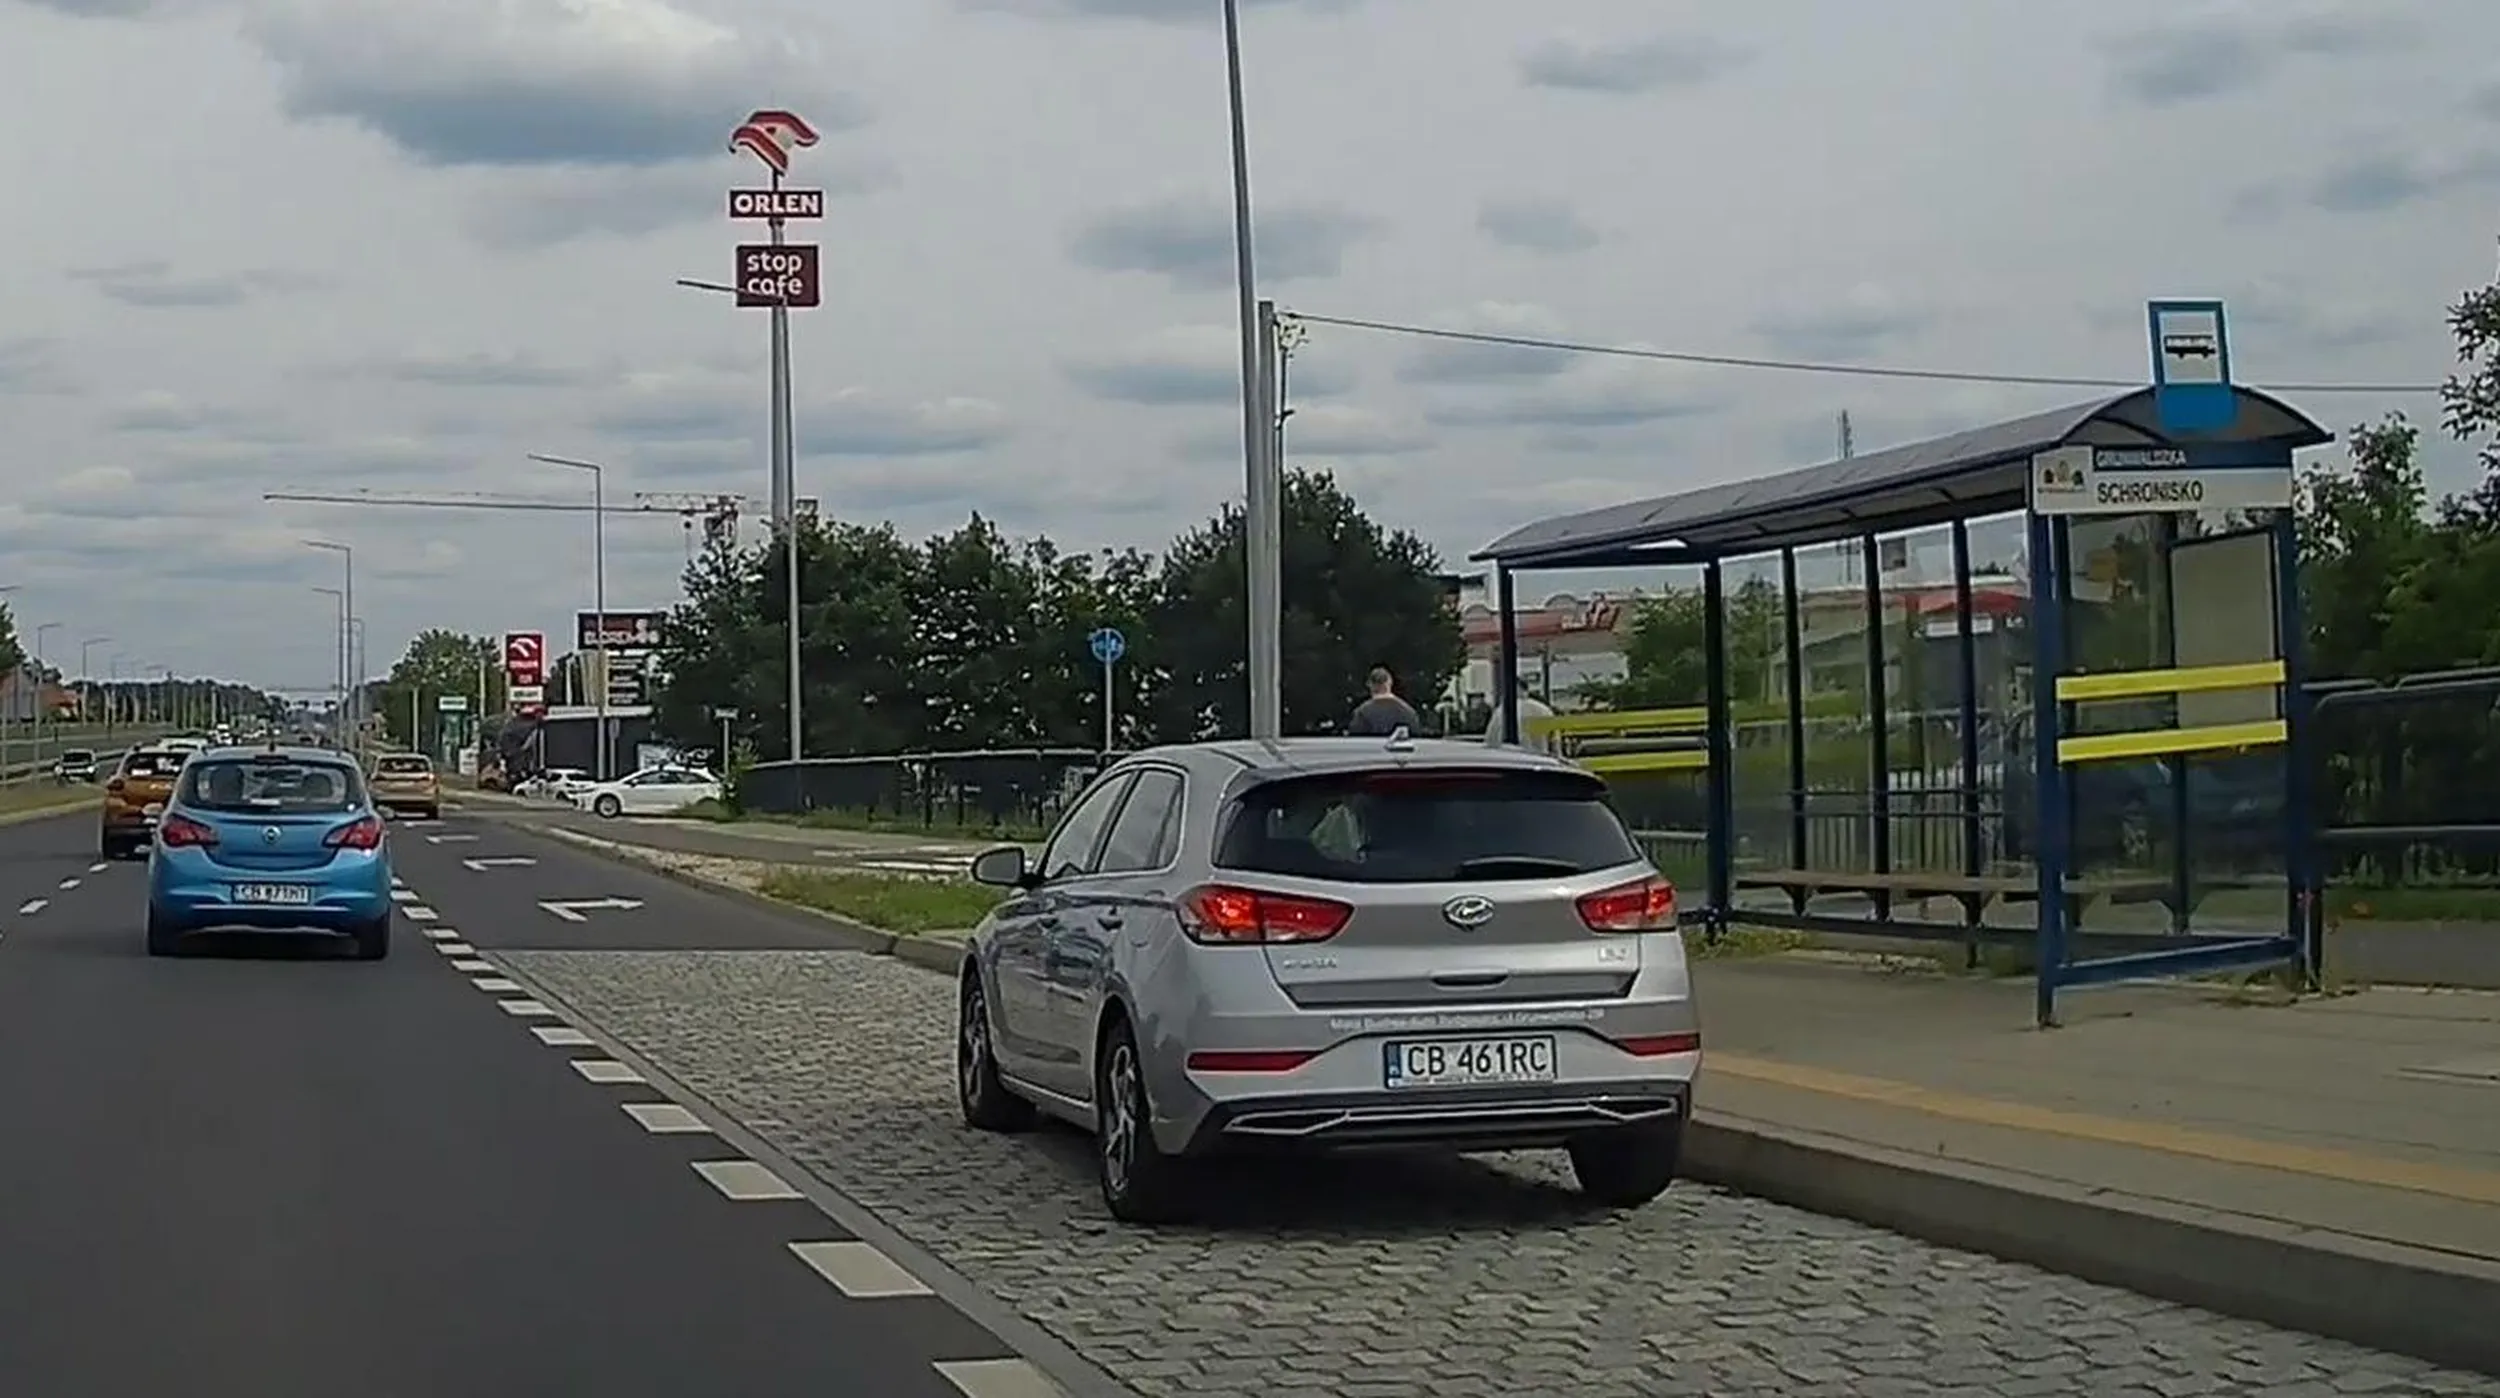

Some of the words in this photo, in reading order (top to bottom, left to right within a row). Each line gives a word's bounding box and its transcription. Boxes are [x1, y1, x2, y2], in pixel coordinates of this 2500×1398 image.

[734, 194, 819, 214] ORLEN
[747, 252, 802, 276] stop
[747, 275, 803, 297] cafe
[2096, 449, 2187, 468] GRUALDZKA
[2097, 480, 2204, 504] SCHRONISKO
[1408, 1046, 1446, 1075] CB
[1457, 1041, 1547, 1076] 461RC
